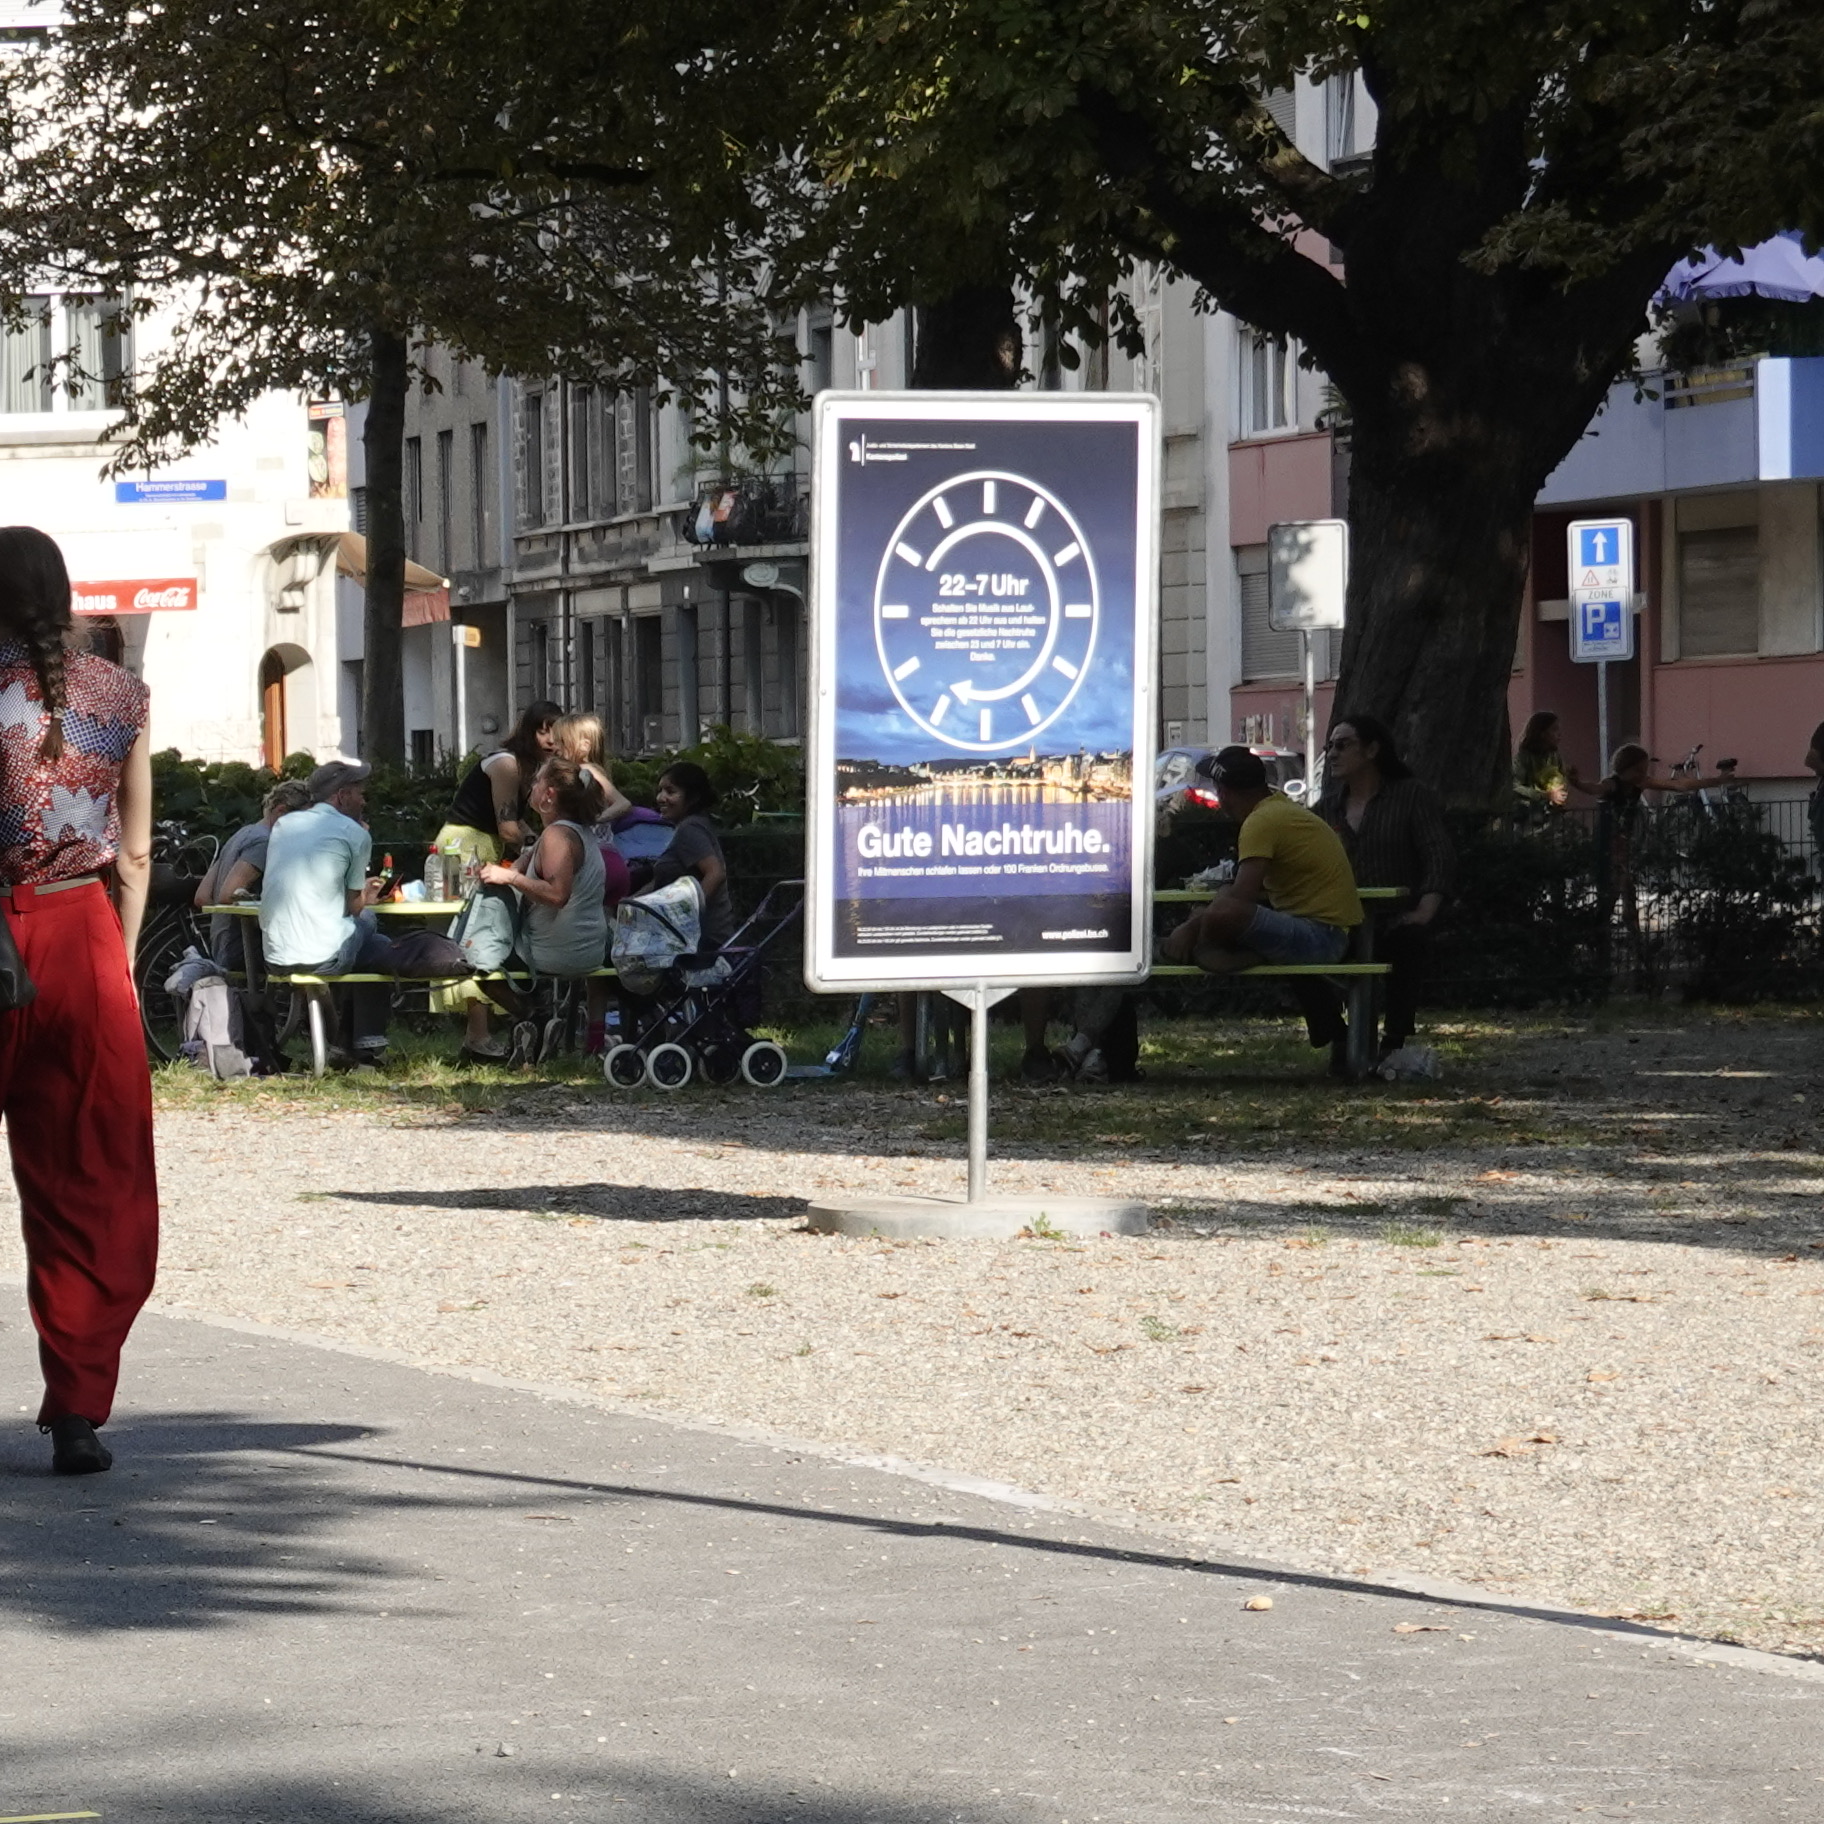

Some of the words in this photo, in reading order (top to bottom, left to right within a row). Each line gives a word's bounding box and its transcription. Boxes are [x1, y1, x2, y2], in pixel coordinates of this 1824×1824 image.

[136, 483, 207, 492] Hammerstrasse
[992, 574, 1029, 596] Uhr
[1588, 590, 1614, 600] ZONE
[72, 591, 117, 610] haus
[133, 586, 191, 609] Coca-Cola
[1586, 604, 1606, 634] P
[857, 825, 932, 858] Gute
[942, 822, 1110, 856] Nachtruhe.
[926, 865, 956, 876] schlafen
[958, 866, 982, 875] lassen
[984, 865, 1002, 875] oder
[1018, 864, 1047, 874] Franken
